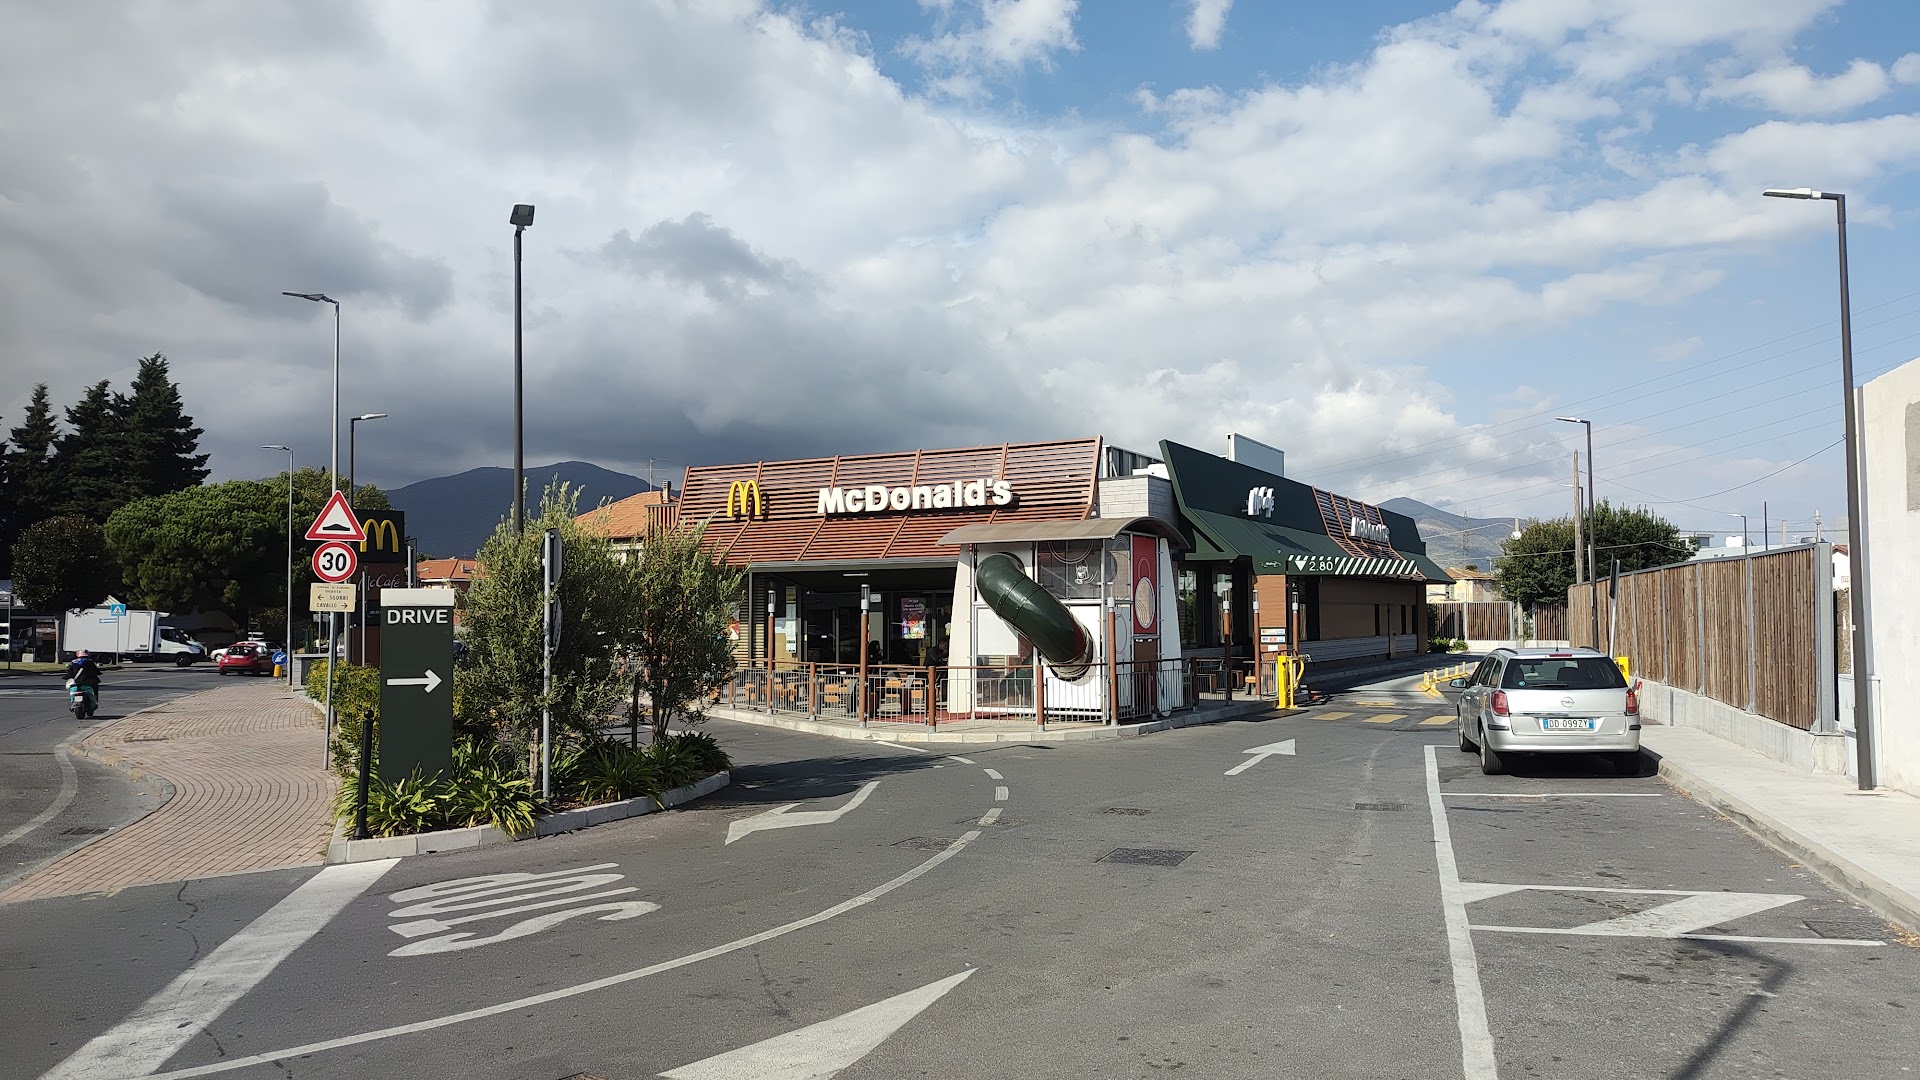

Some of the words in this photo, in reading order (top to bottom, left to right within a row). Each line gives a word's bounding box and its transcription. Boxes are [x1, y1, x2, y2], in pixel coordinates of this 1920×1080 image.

[817, 479, 1012, 513] McDonald's
[322, 552, 347, 571] 30
[1308, 561, 1334, 571] 2.80
[387, 609, 448, 624] DRIVE
[387, 862, 662, 957] STOP
